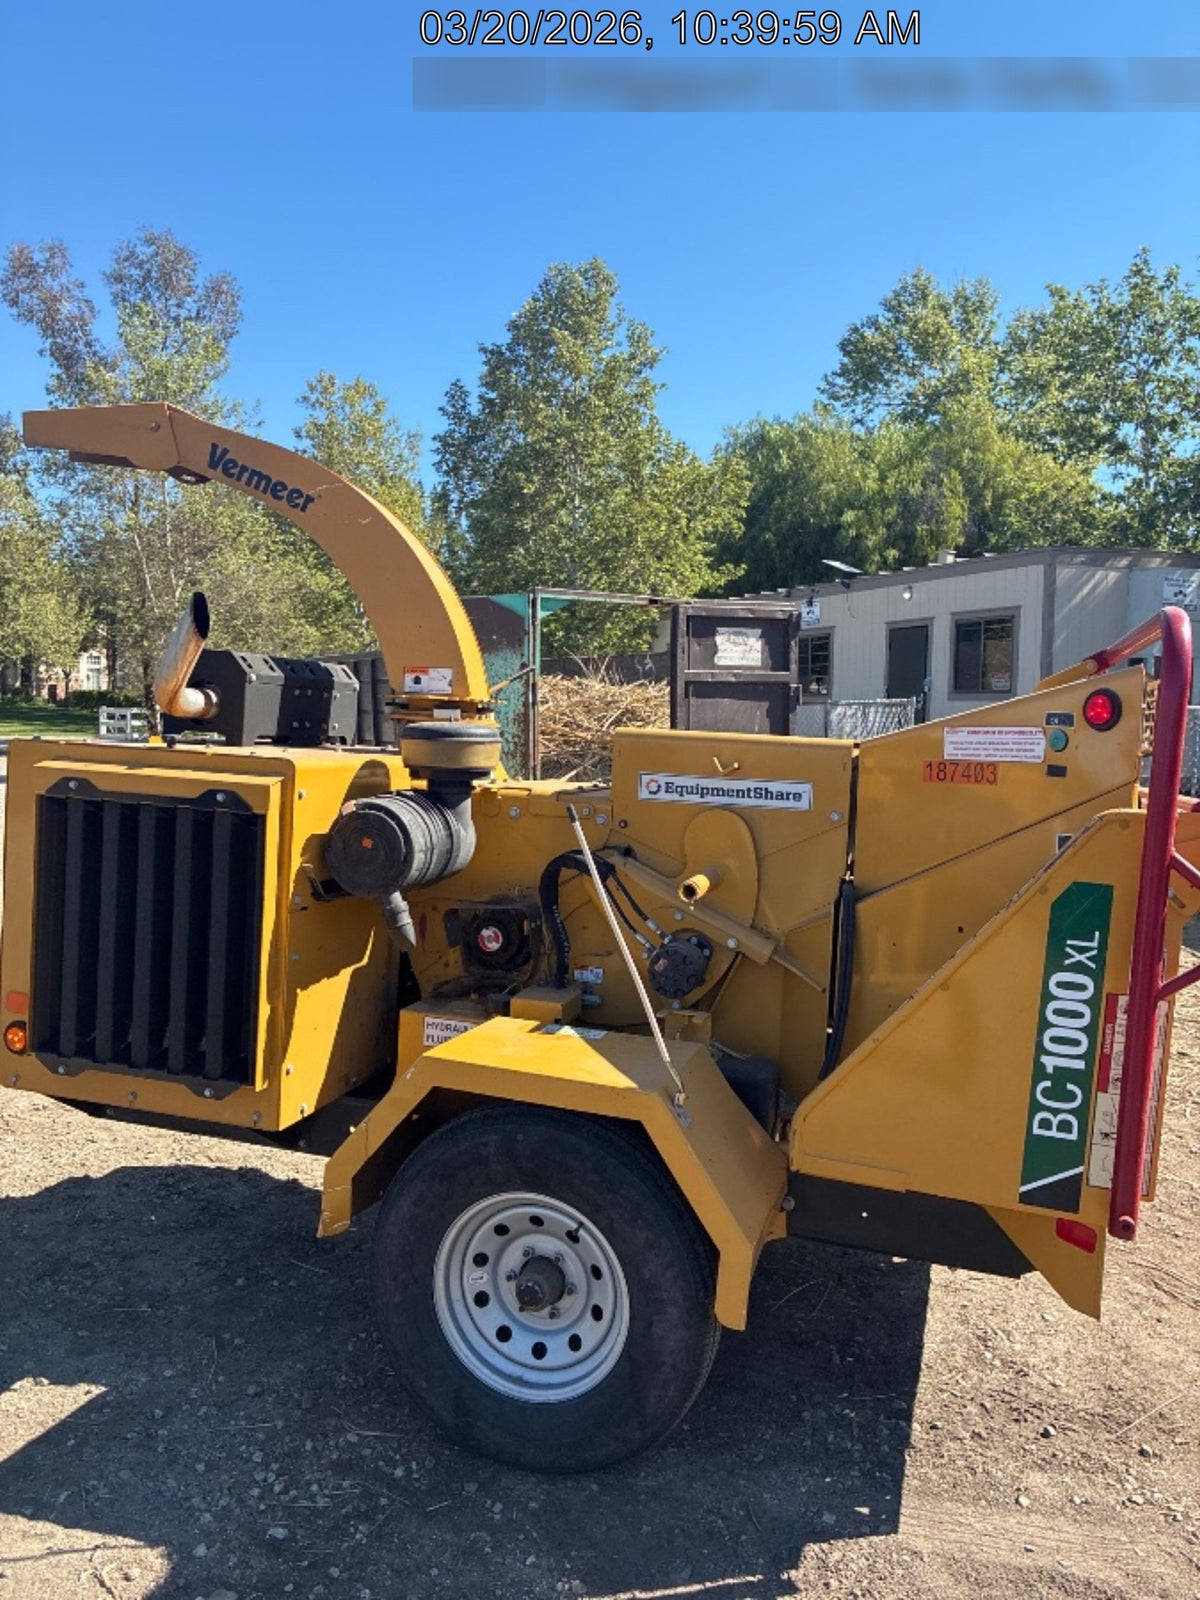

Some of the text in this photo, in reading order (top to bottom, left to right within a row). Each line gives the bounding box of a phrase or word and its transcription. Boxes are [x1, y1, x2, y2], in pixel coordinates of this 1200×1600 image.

[207, 442, 315, 513] Vermeer
[925, 761, 998, 785] 187403
[664, 781, 803, 803] EquipmentShare
